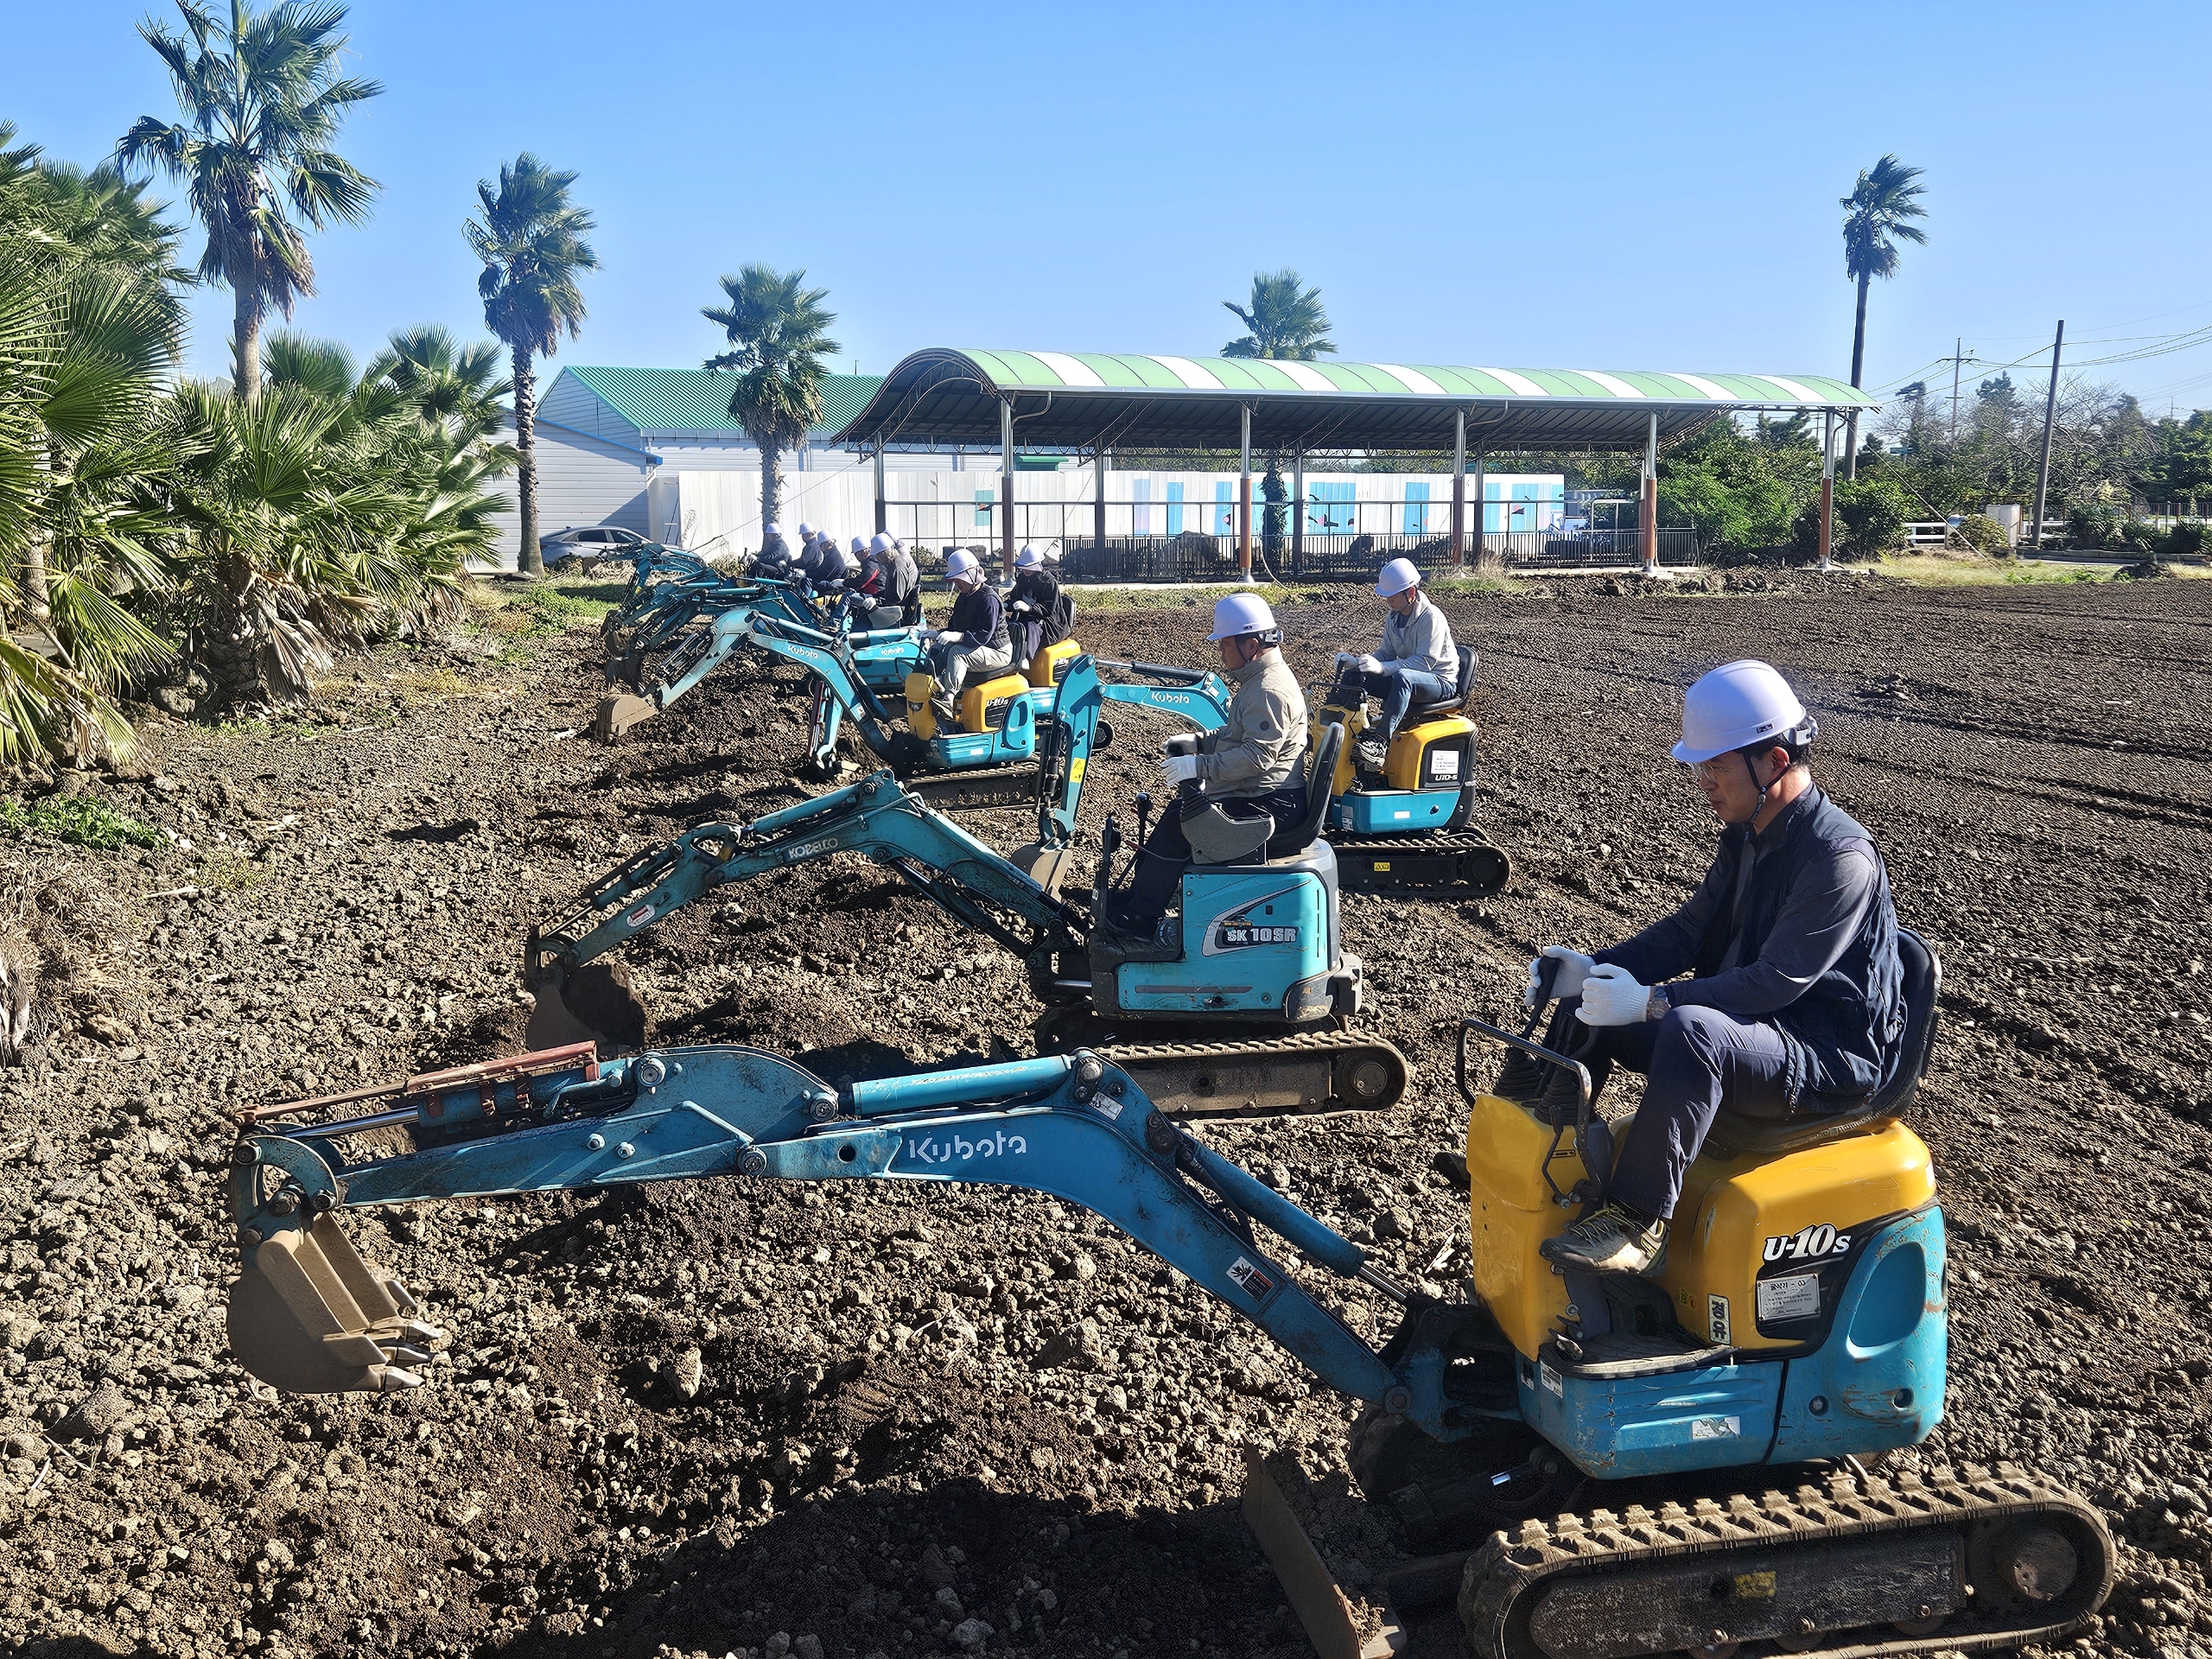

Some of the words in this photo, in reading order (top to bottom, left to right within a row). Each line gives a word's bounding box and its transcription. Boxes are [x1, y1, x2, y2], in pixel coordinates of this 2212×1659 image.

[788, 644, 818, 659] Kubota
[1152, 691, 1190, 704] Kubota
[1227, 929, 1248, 942] SK
[1250, 928, 1296, 942] 10SR
[909, 1130, 1027, 1164] Kubota
[1764, 1224, 1852, 1261] U-10s
